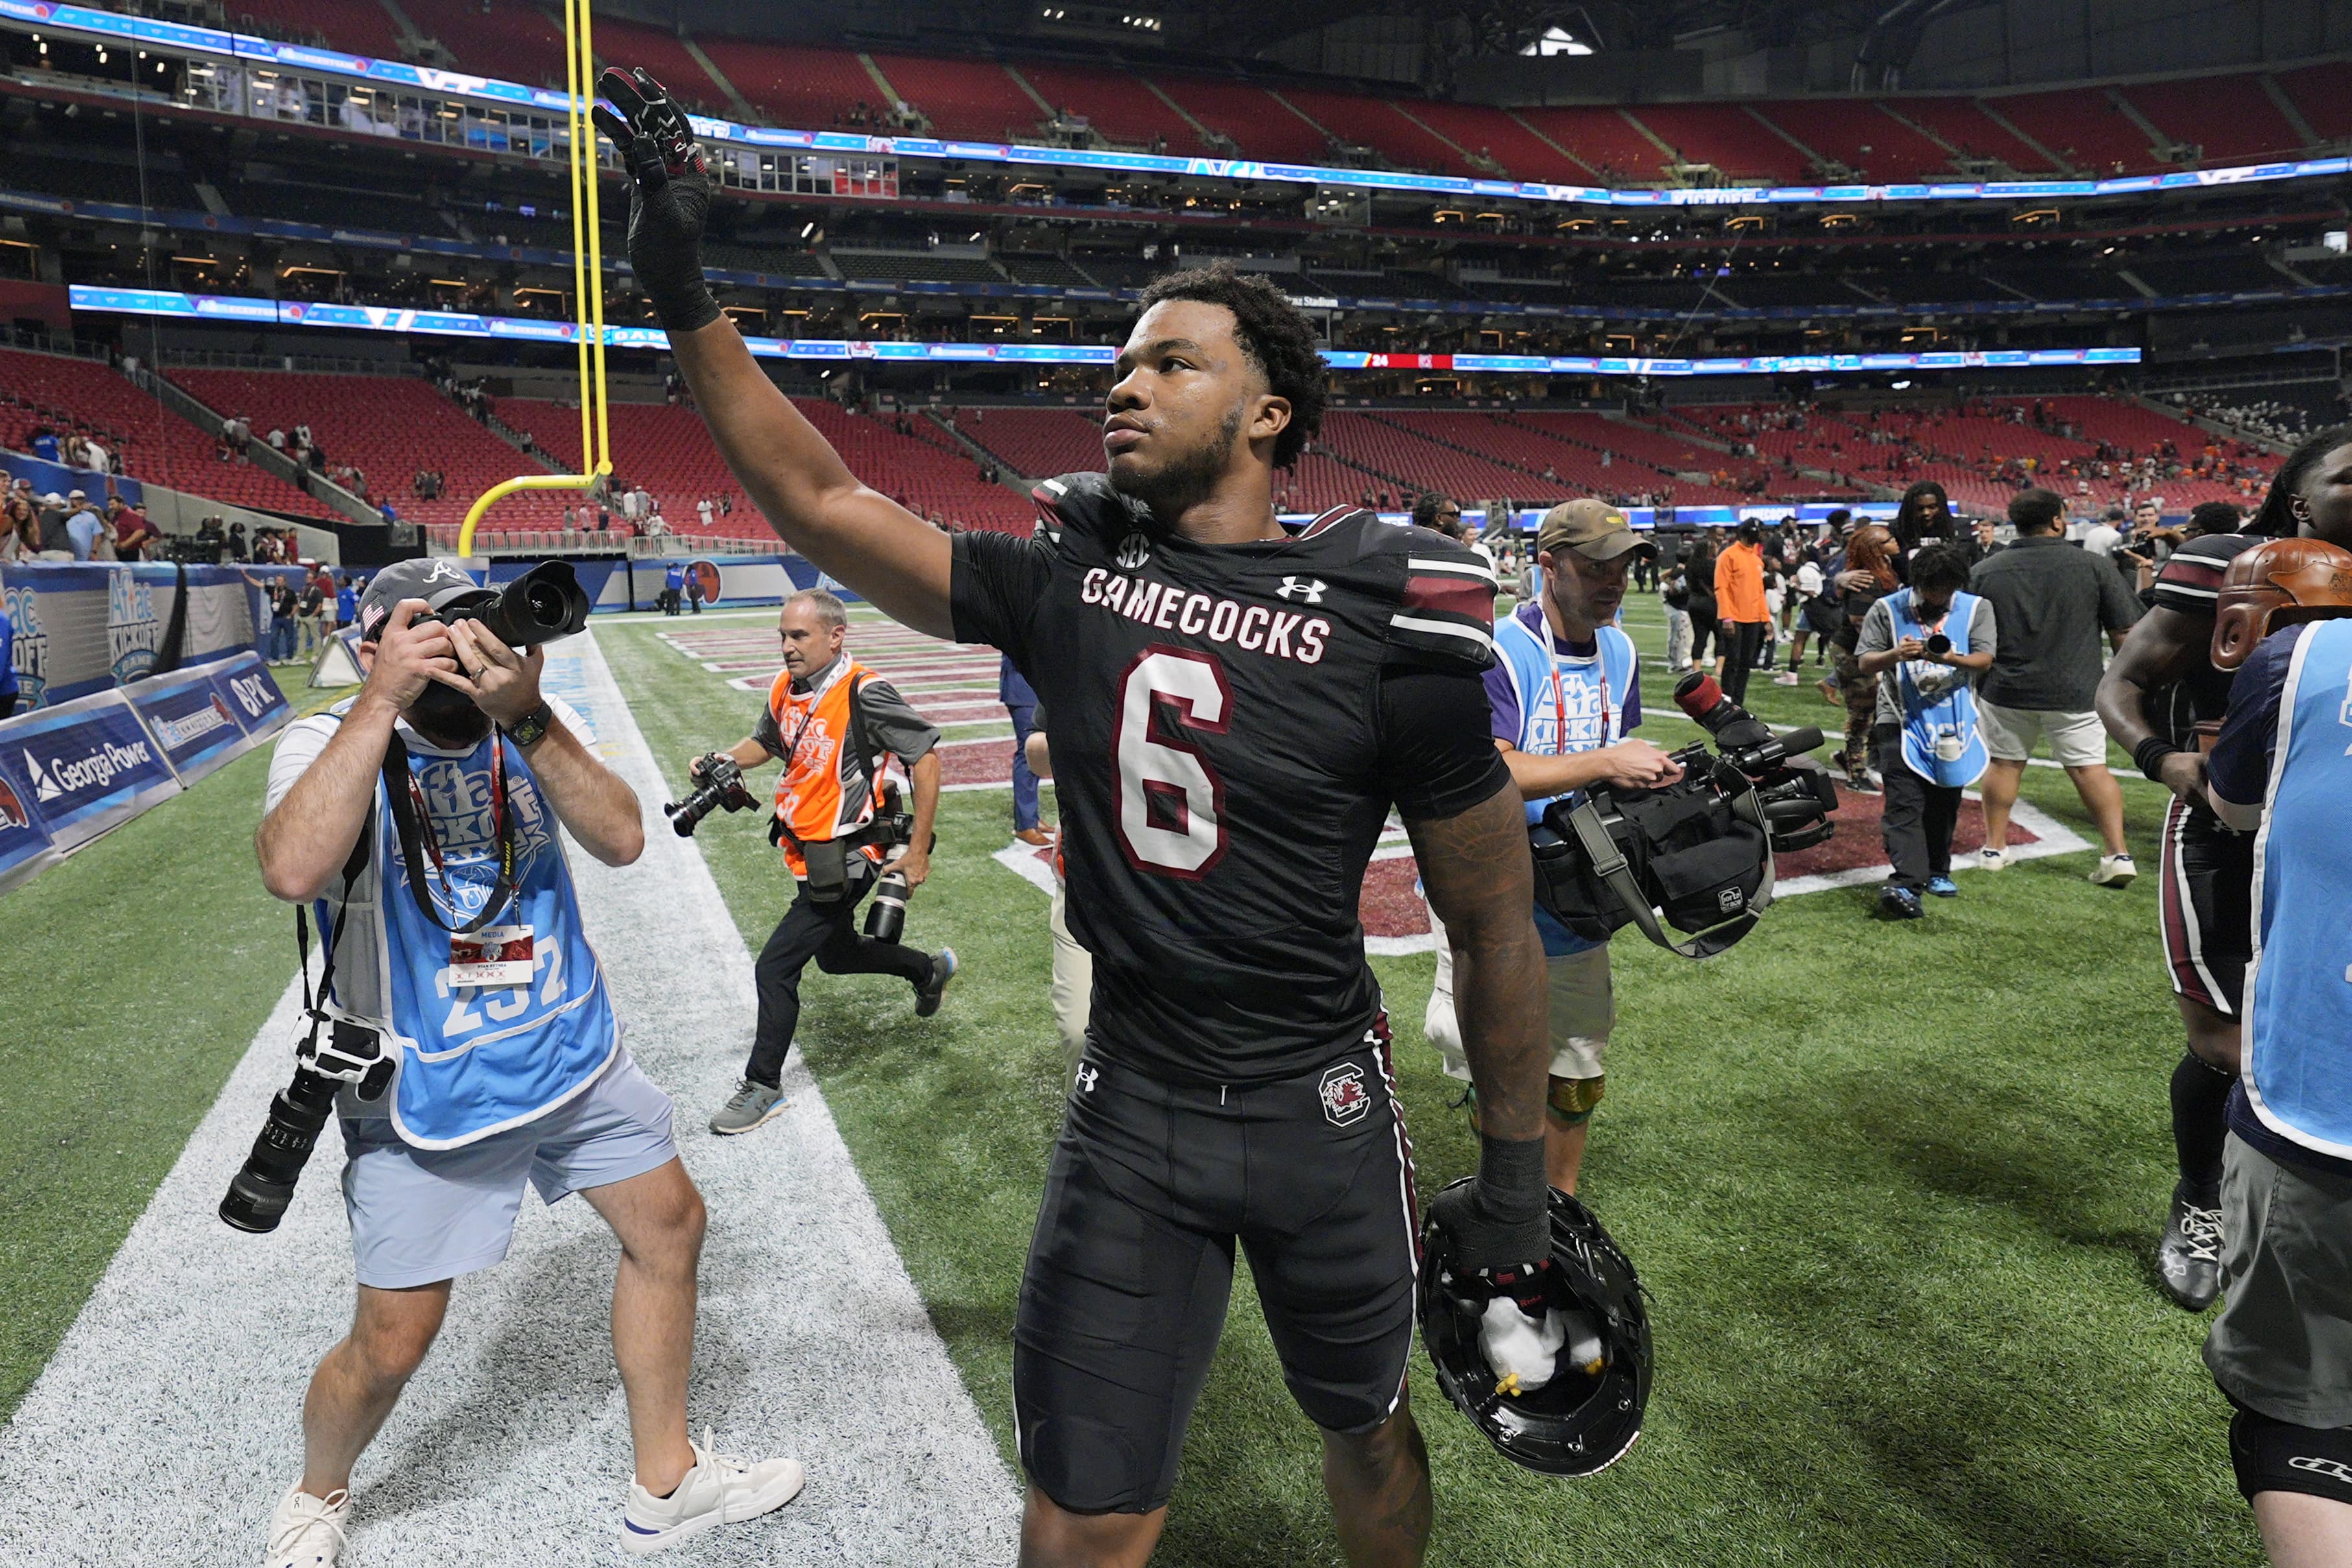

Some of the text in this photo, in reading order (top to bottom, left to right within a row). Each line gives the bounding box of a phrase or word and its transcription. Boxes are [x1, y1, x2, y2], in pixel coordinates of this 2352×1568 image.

[1304, 296, 1338, 307] Stadium
[613, 330, 668, 343] GAM
[1372, 354, 1388, 368] 24
[1116, 532, 1150, 568] SEC
[422, 560, 460, 584] A
[1080, 567, 1331, 665] GAMECOCKS
[1533, 674, 1611, 717] Afla
[1529, 713, 1622, 750] KICKOF
[51, 741, 151, 791] Georgia Power
[1111, 642, 1235, 879] 6
